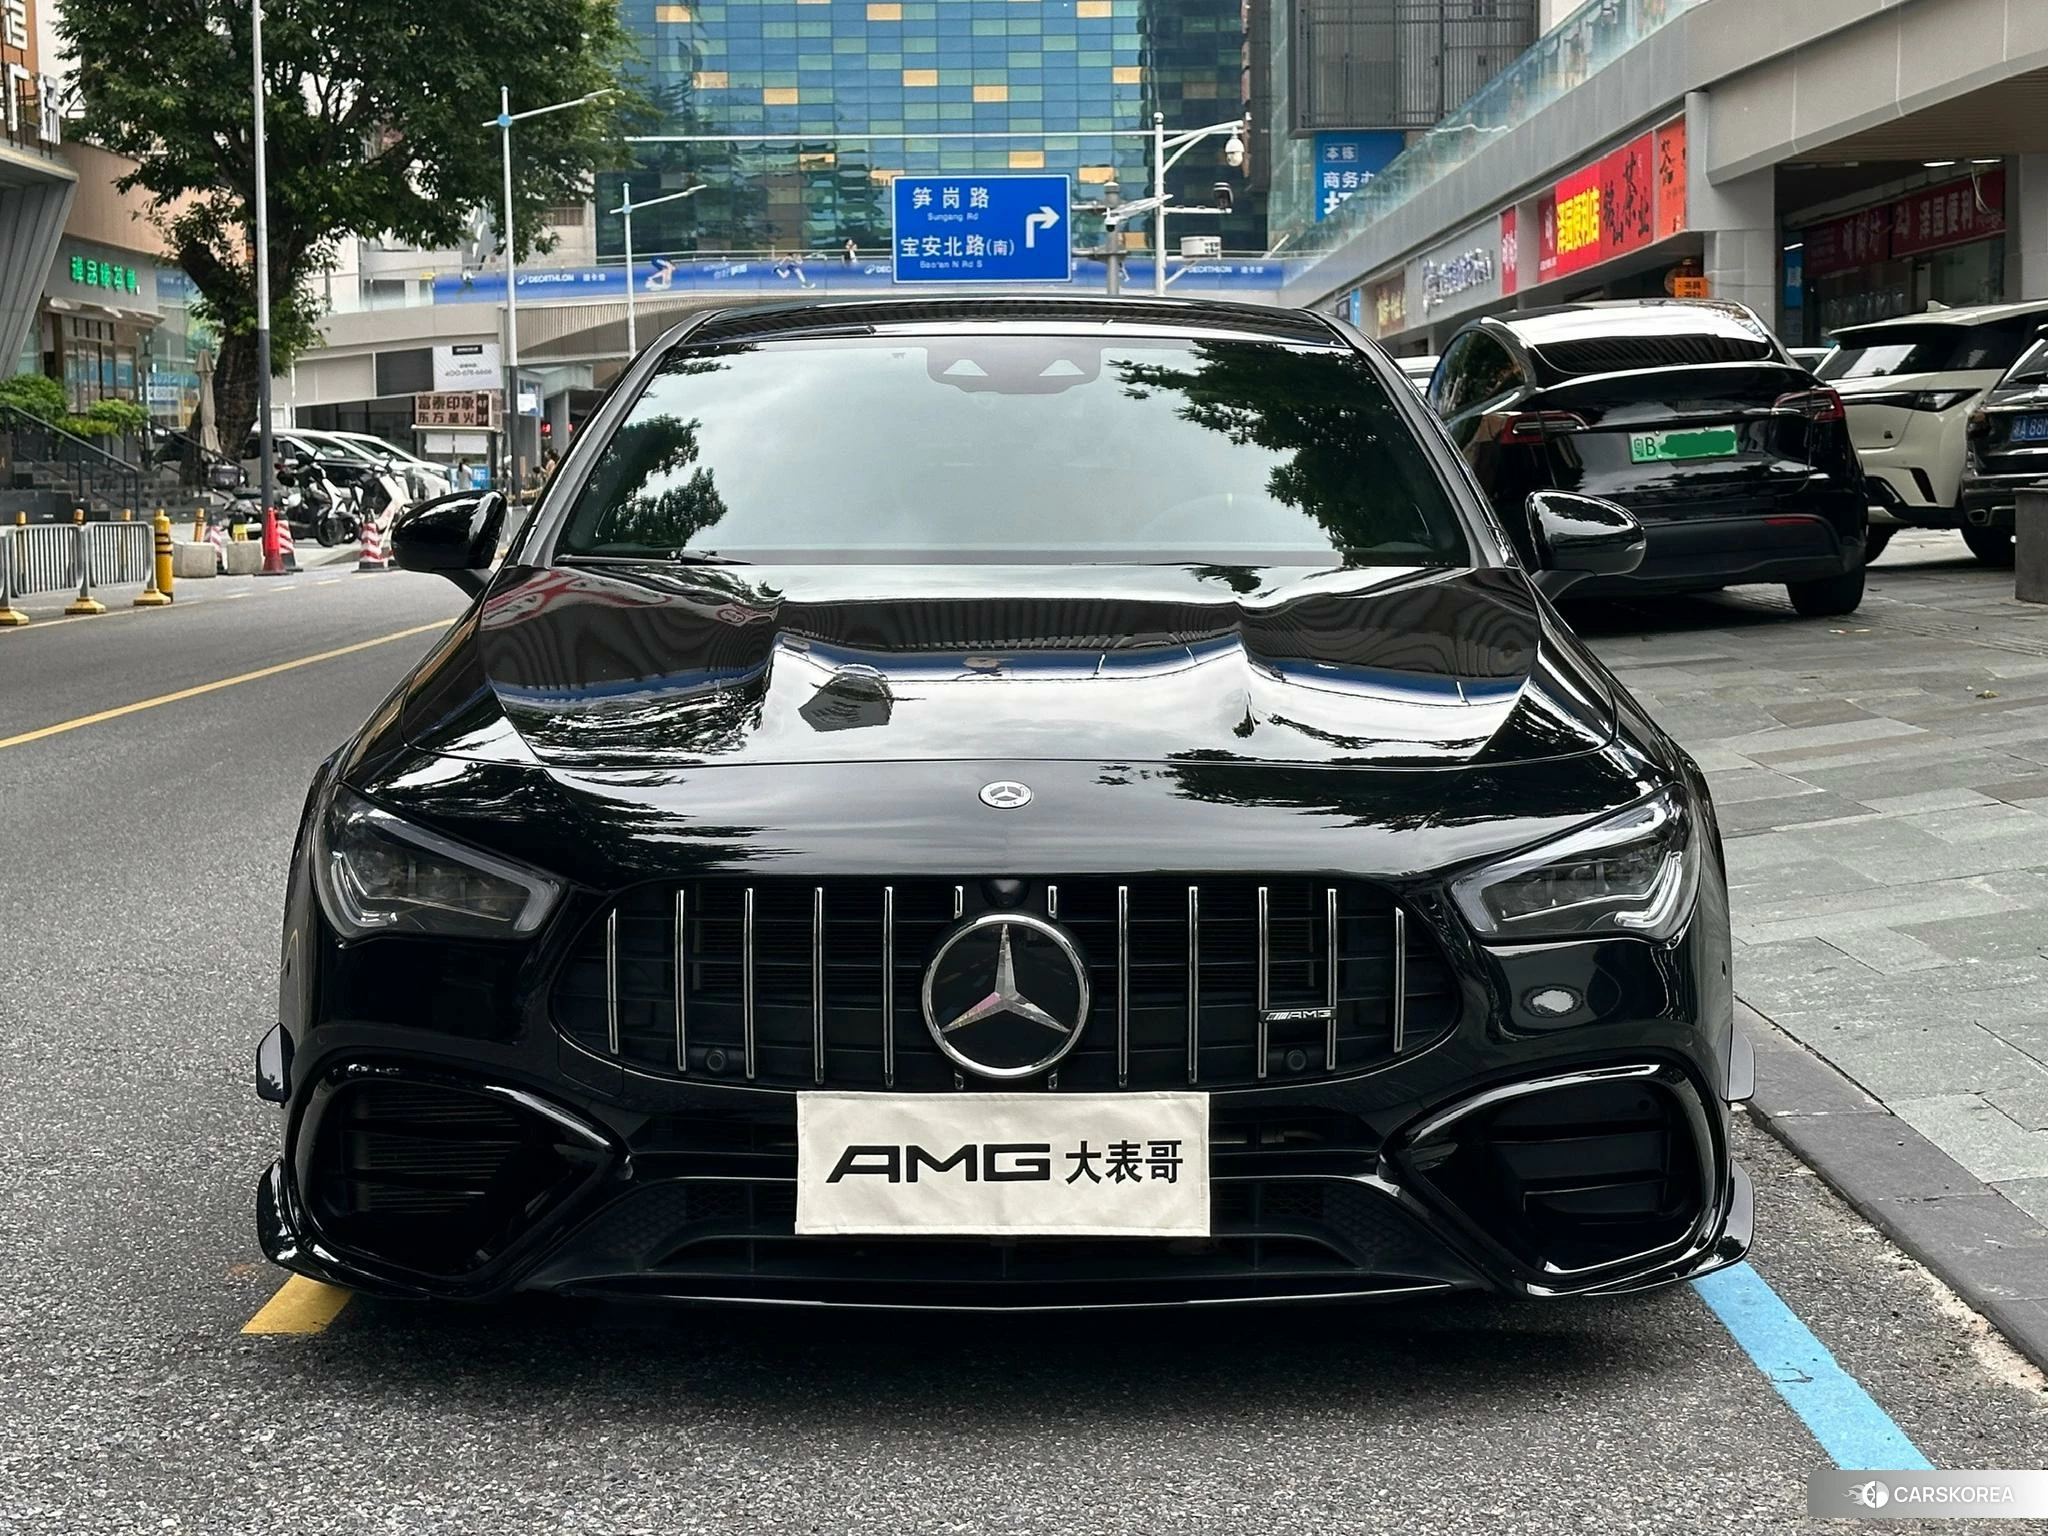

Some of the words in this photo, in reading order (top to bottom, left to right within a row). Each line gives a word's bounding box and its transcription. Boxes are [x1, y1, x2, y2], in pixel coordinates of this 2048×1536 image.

[912, 186, 990, 209] 笋岗路
[927, 212, 964, 222] Sungang
[966, 212, 979, 221] Rd
[900, 234, 1015, 257] 宝安北路(南)
[919, 260, 950, 269] Bao'an
[951, 260, 960, 268] N
[961, 260, 974, 268] Rd
[976, 260, 983, 268] S
[417, 411, 475, 424] 东方星火
[1287, 1009, 1332, 1020] AMG
[825, 1143, 1051, 1184] AMG
[1065, 1139, 1184, 1184] 大表哥
